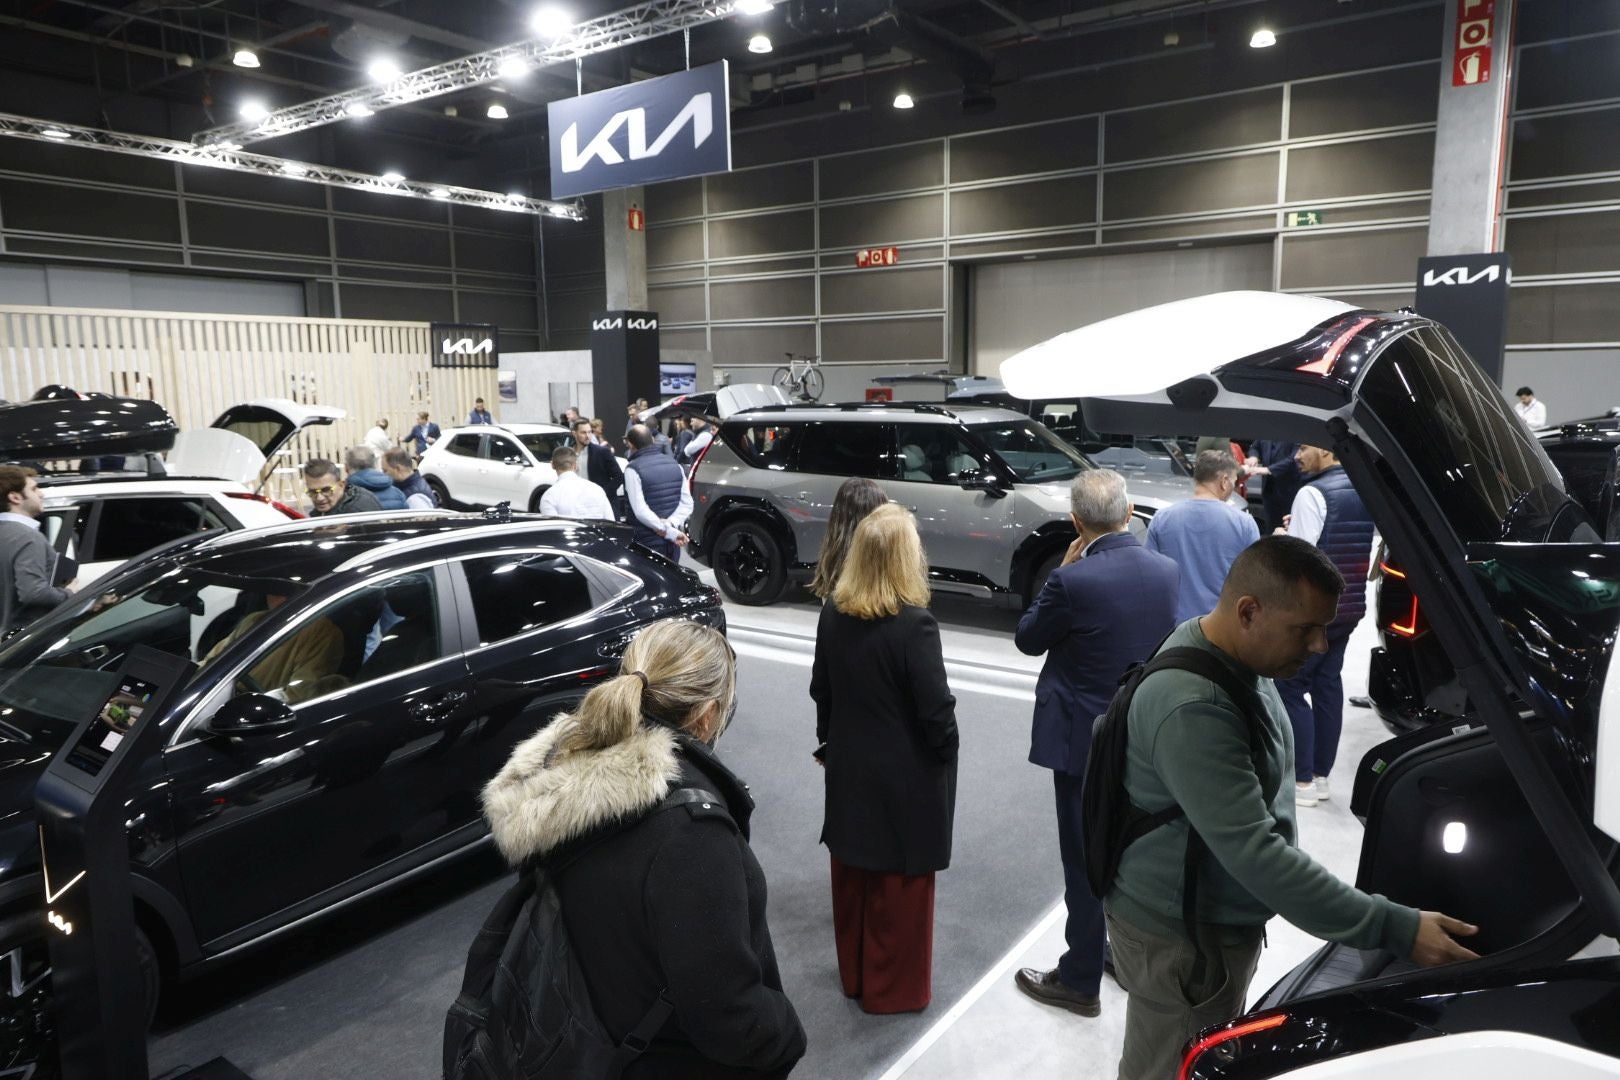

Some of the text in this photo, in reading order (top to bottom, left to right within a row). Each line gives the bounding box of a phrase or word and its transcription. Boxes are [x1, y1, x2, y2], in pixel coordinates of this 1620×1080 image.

[561, 92, 712, 173] KIA
[1424, 265, 1499, 286] KIA
[593, 317, 622, 330] KIA
[628, 318, 657, 329] KIA
[443, 338, 493, 354] KIA
